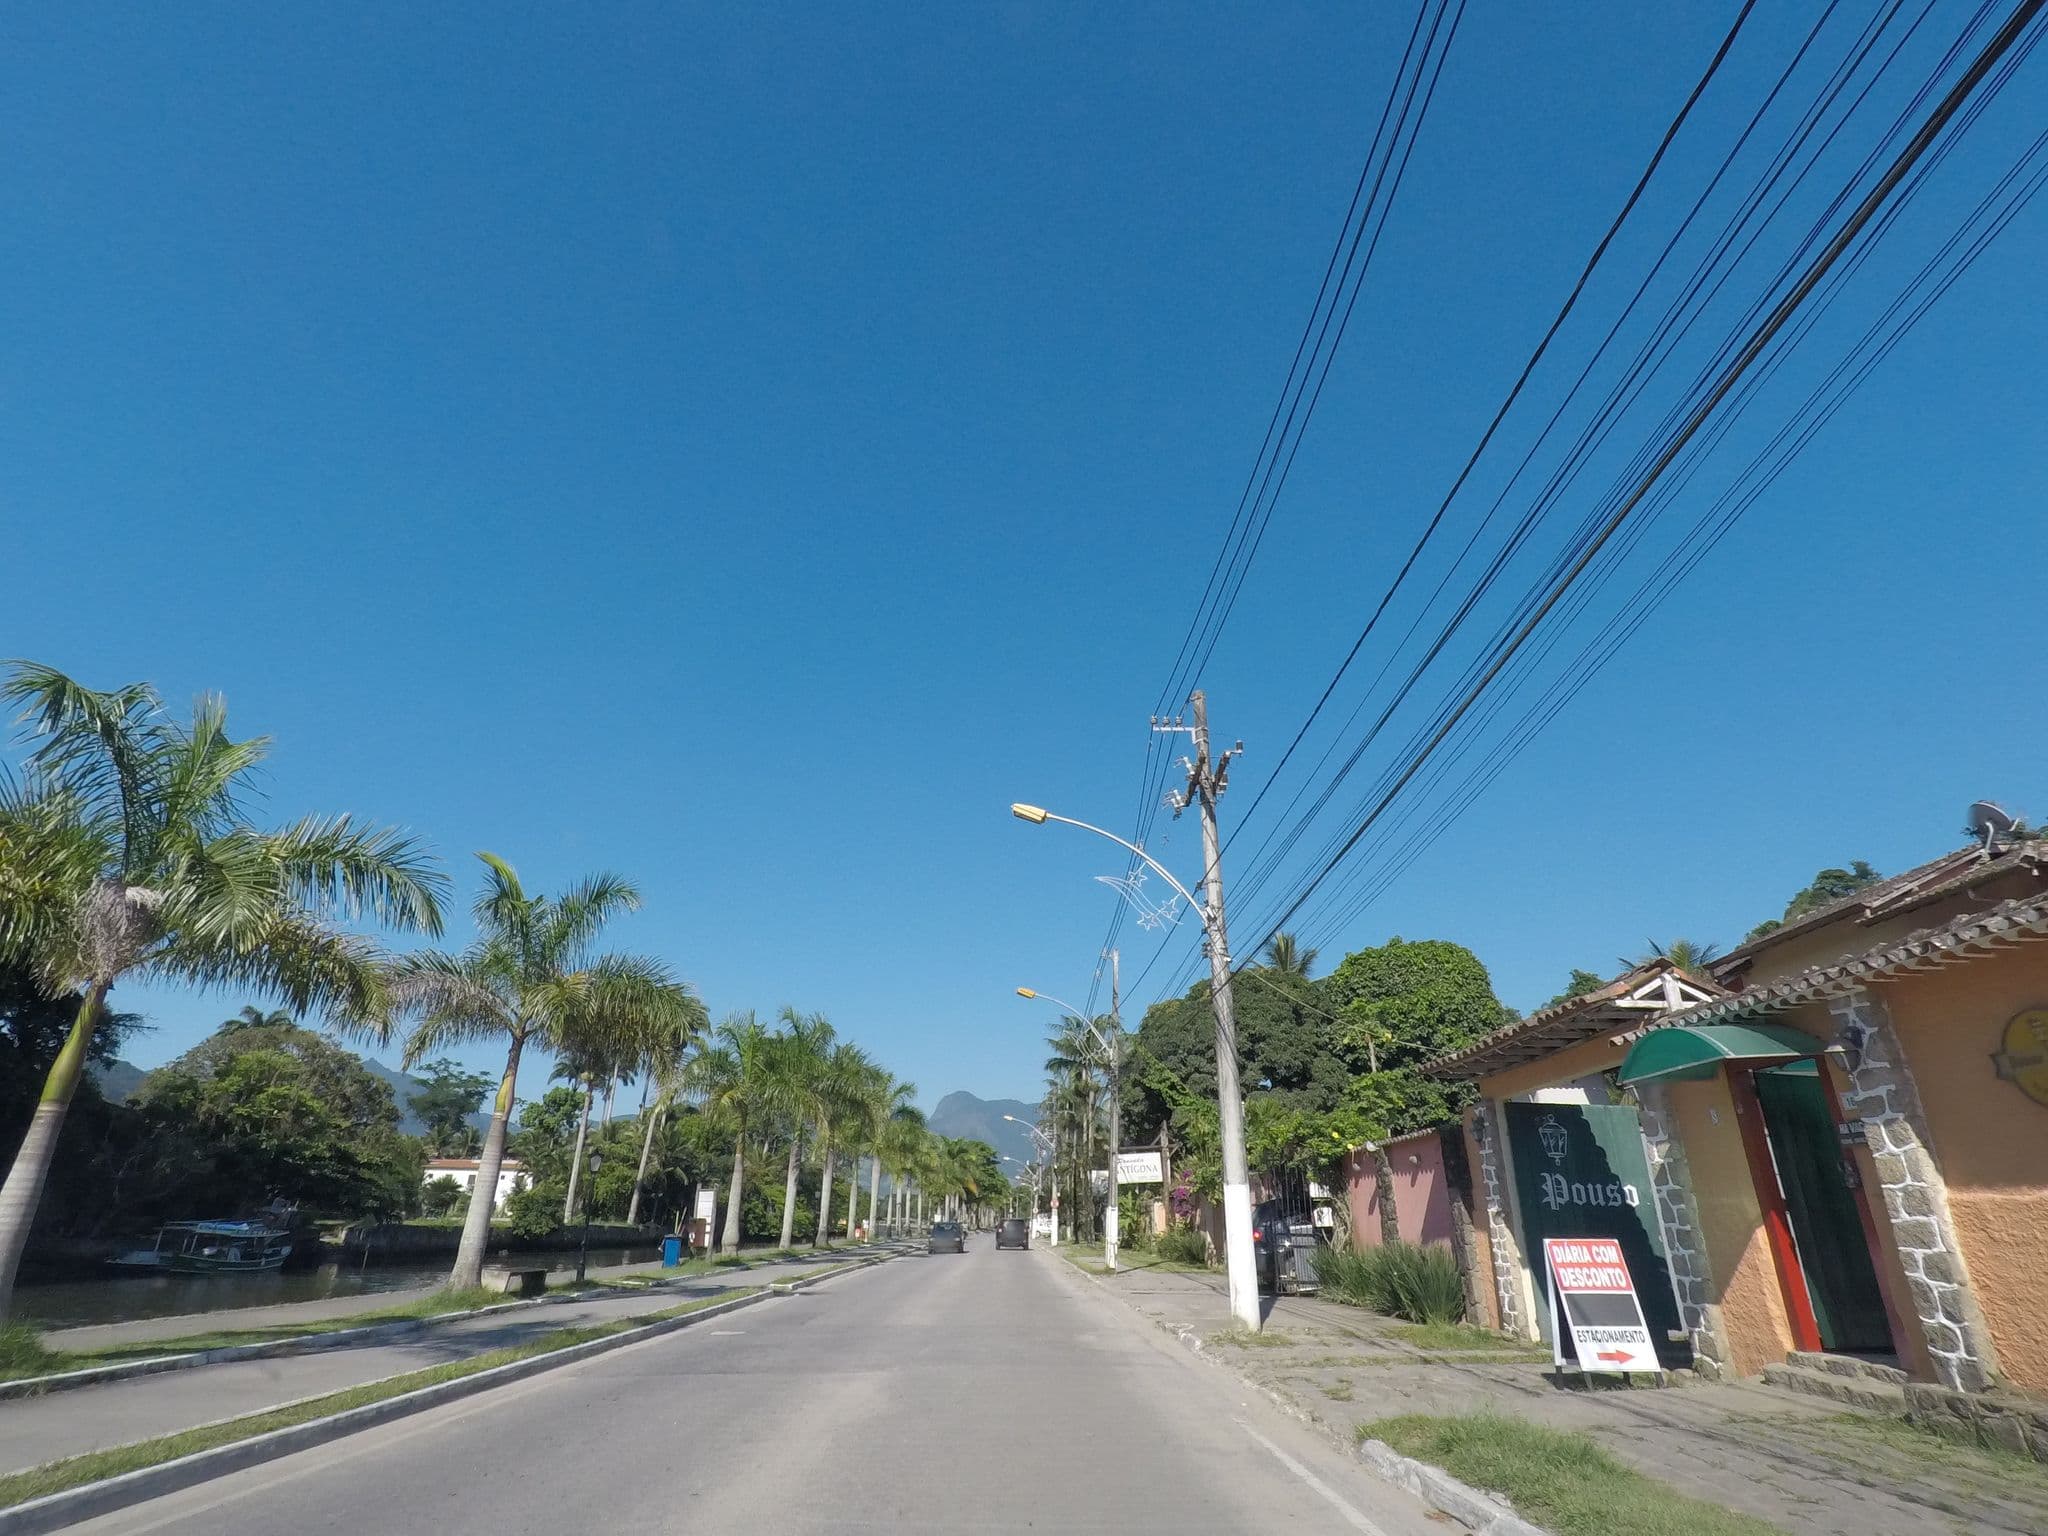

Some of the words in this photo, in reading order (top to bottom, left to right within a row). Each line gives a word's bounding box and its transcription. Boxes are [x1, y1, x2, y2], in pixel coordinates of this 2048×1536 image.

[1540, 1172, 1640, 1211] Pouso
[1550, 1242, 1591, 1264] DIÁRIA
[1591, 1244, 1619, 1264] COM
[1557, 1267, 1627, 1288] DESCONTO
[1576, 1329, 1646, 1344] ESTACIONAMENTO
